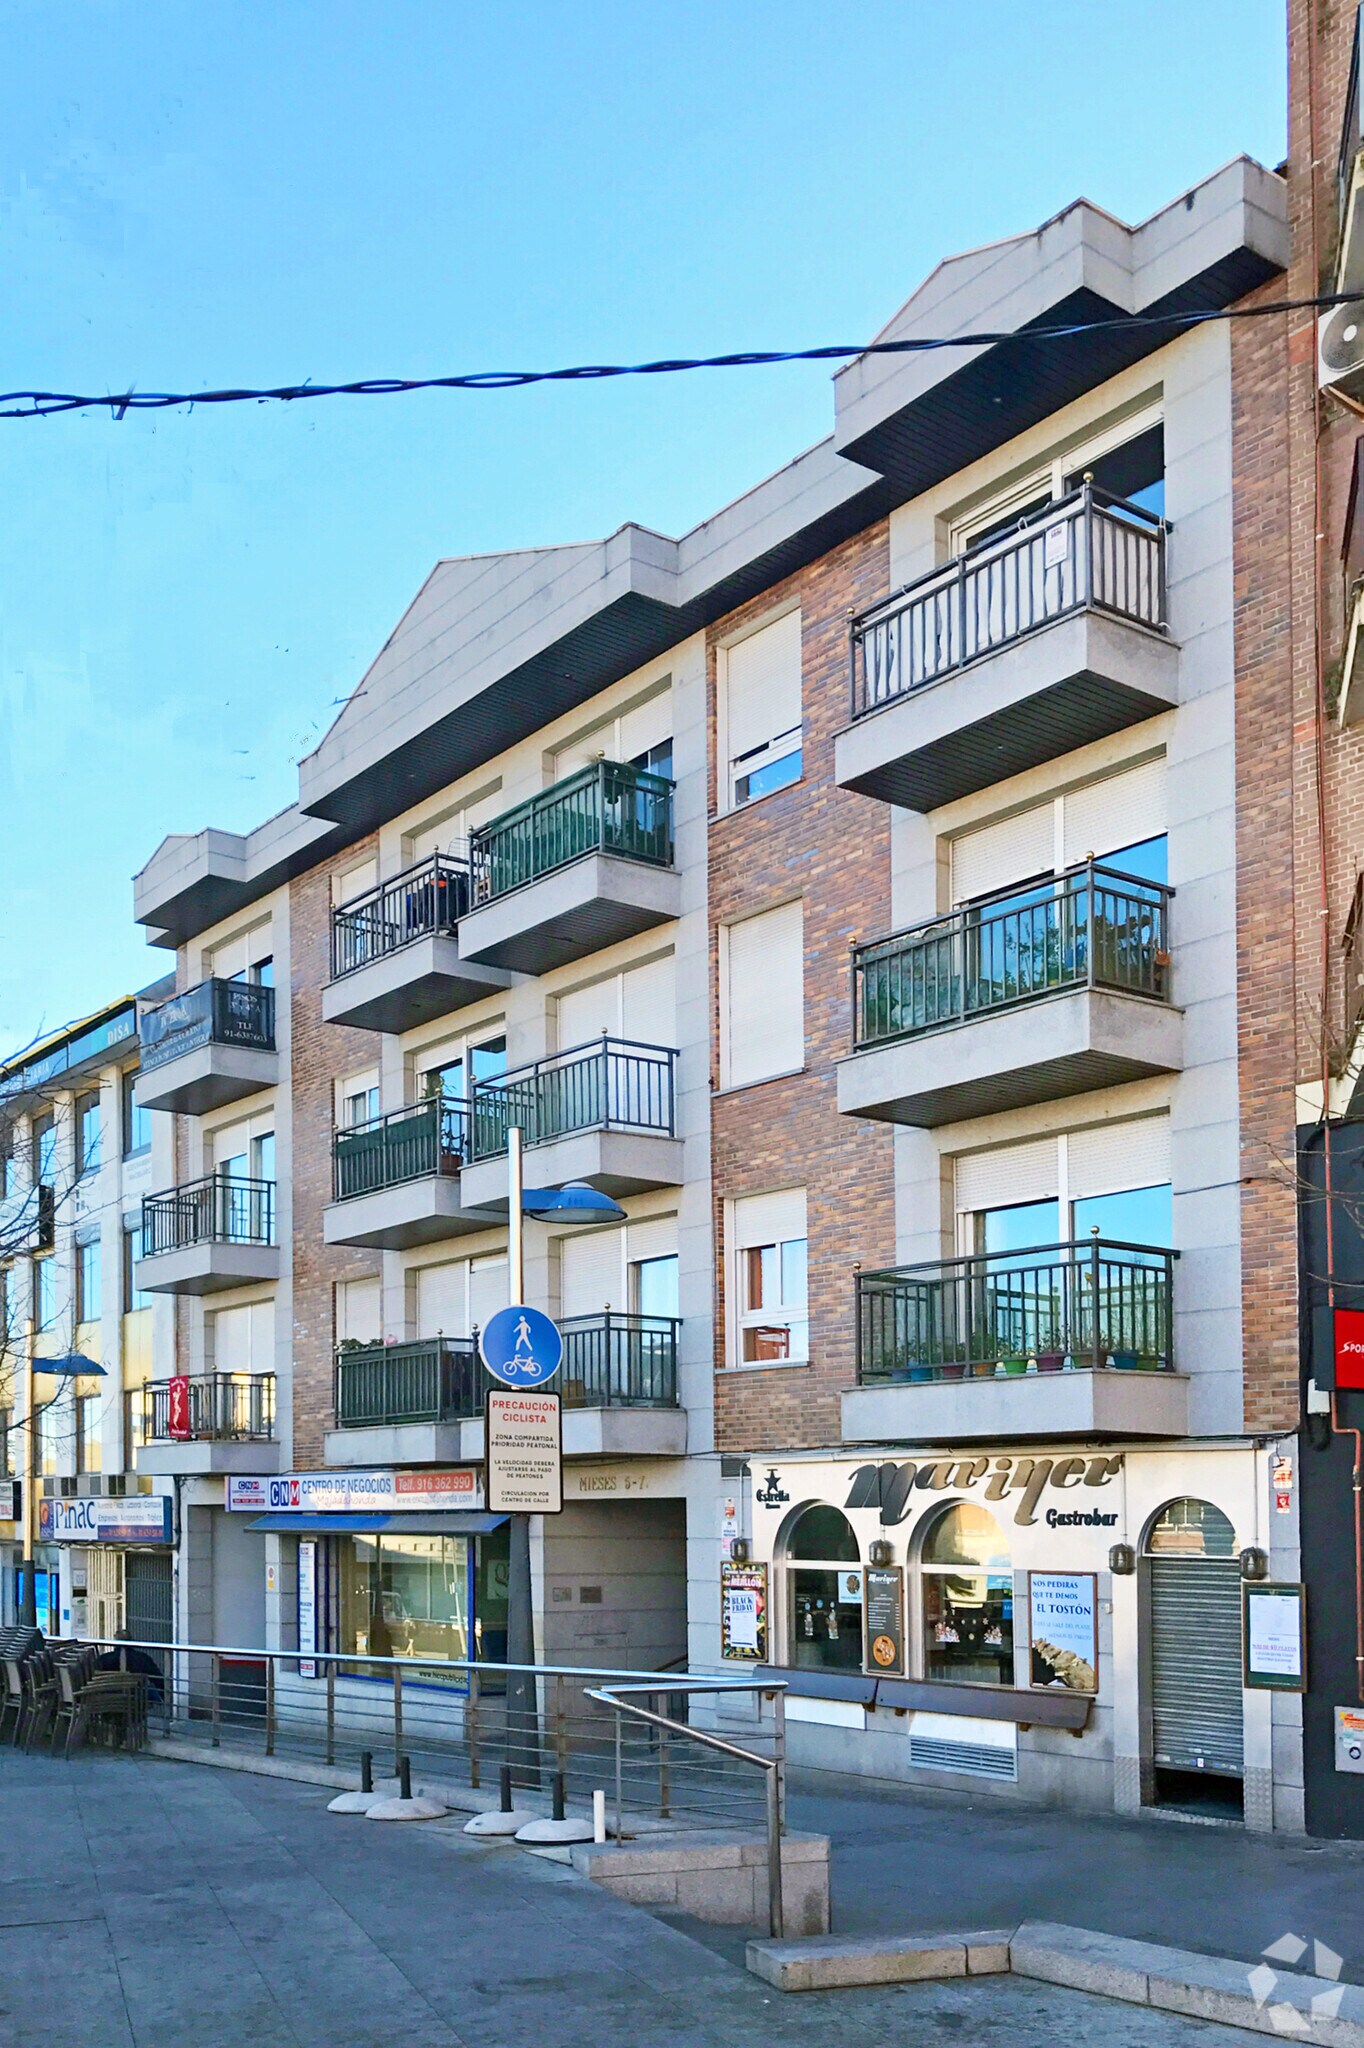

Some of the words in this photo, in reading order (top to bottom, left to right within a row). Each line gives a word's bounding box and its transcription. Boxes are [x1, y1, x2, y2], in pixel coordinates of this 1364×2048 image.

[492, 1400, 556, 1411] PRECAUCIÓN
[502, 1413, 547, 1423] CICLISTA
[301, 1479, 332, 1494] CENTRO
[334, 1479, 346, 1493] DE
[347, 1477, 391, 1493] NEGOCIOS
[416, 1477, 433, 1490] 916
[434, 1476, 452, 1489] 362
[453, 1475, 471, 1489] 990
[579, 1476, 617, 1491] MIESES
[270, 1480, 300, 1506] CNM
[756, 1488, 790, 1503] Estrella
[1046, 1508, 1118, 1529] Gastrobar
[731, 1596, 753, 1604] BLACK
[1055, 1592, 1079, 1600] DEMOS
[1036, 1603, 1046, 1613] EL
[1048, 1603, 1092, 1616] TOSTÓN
